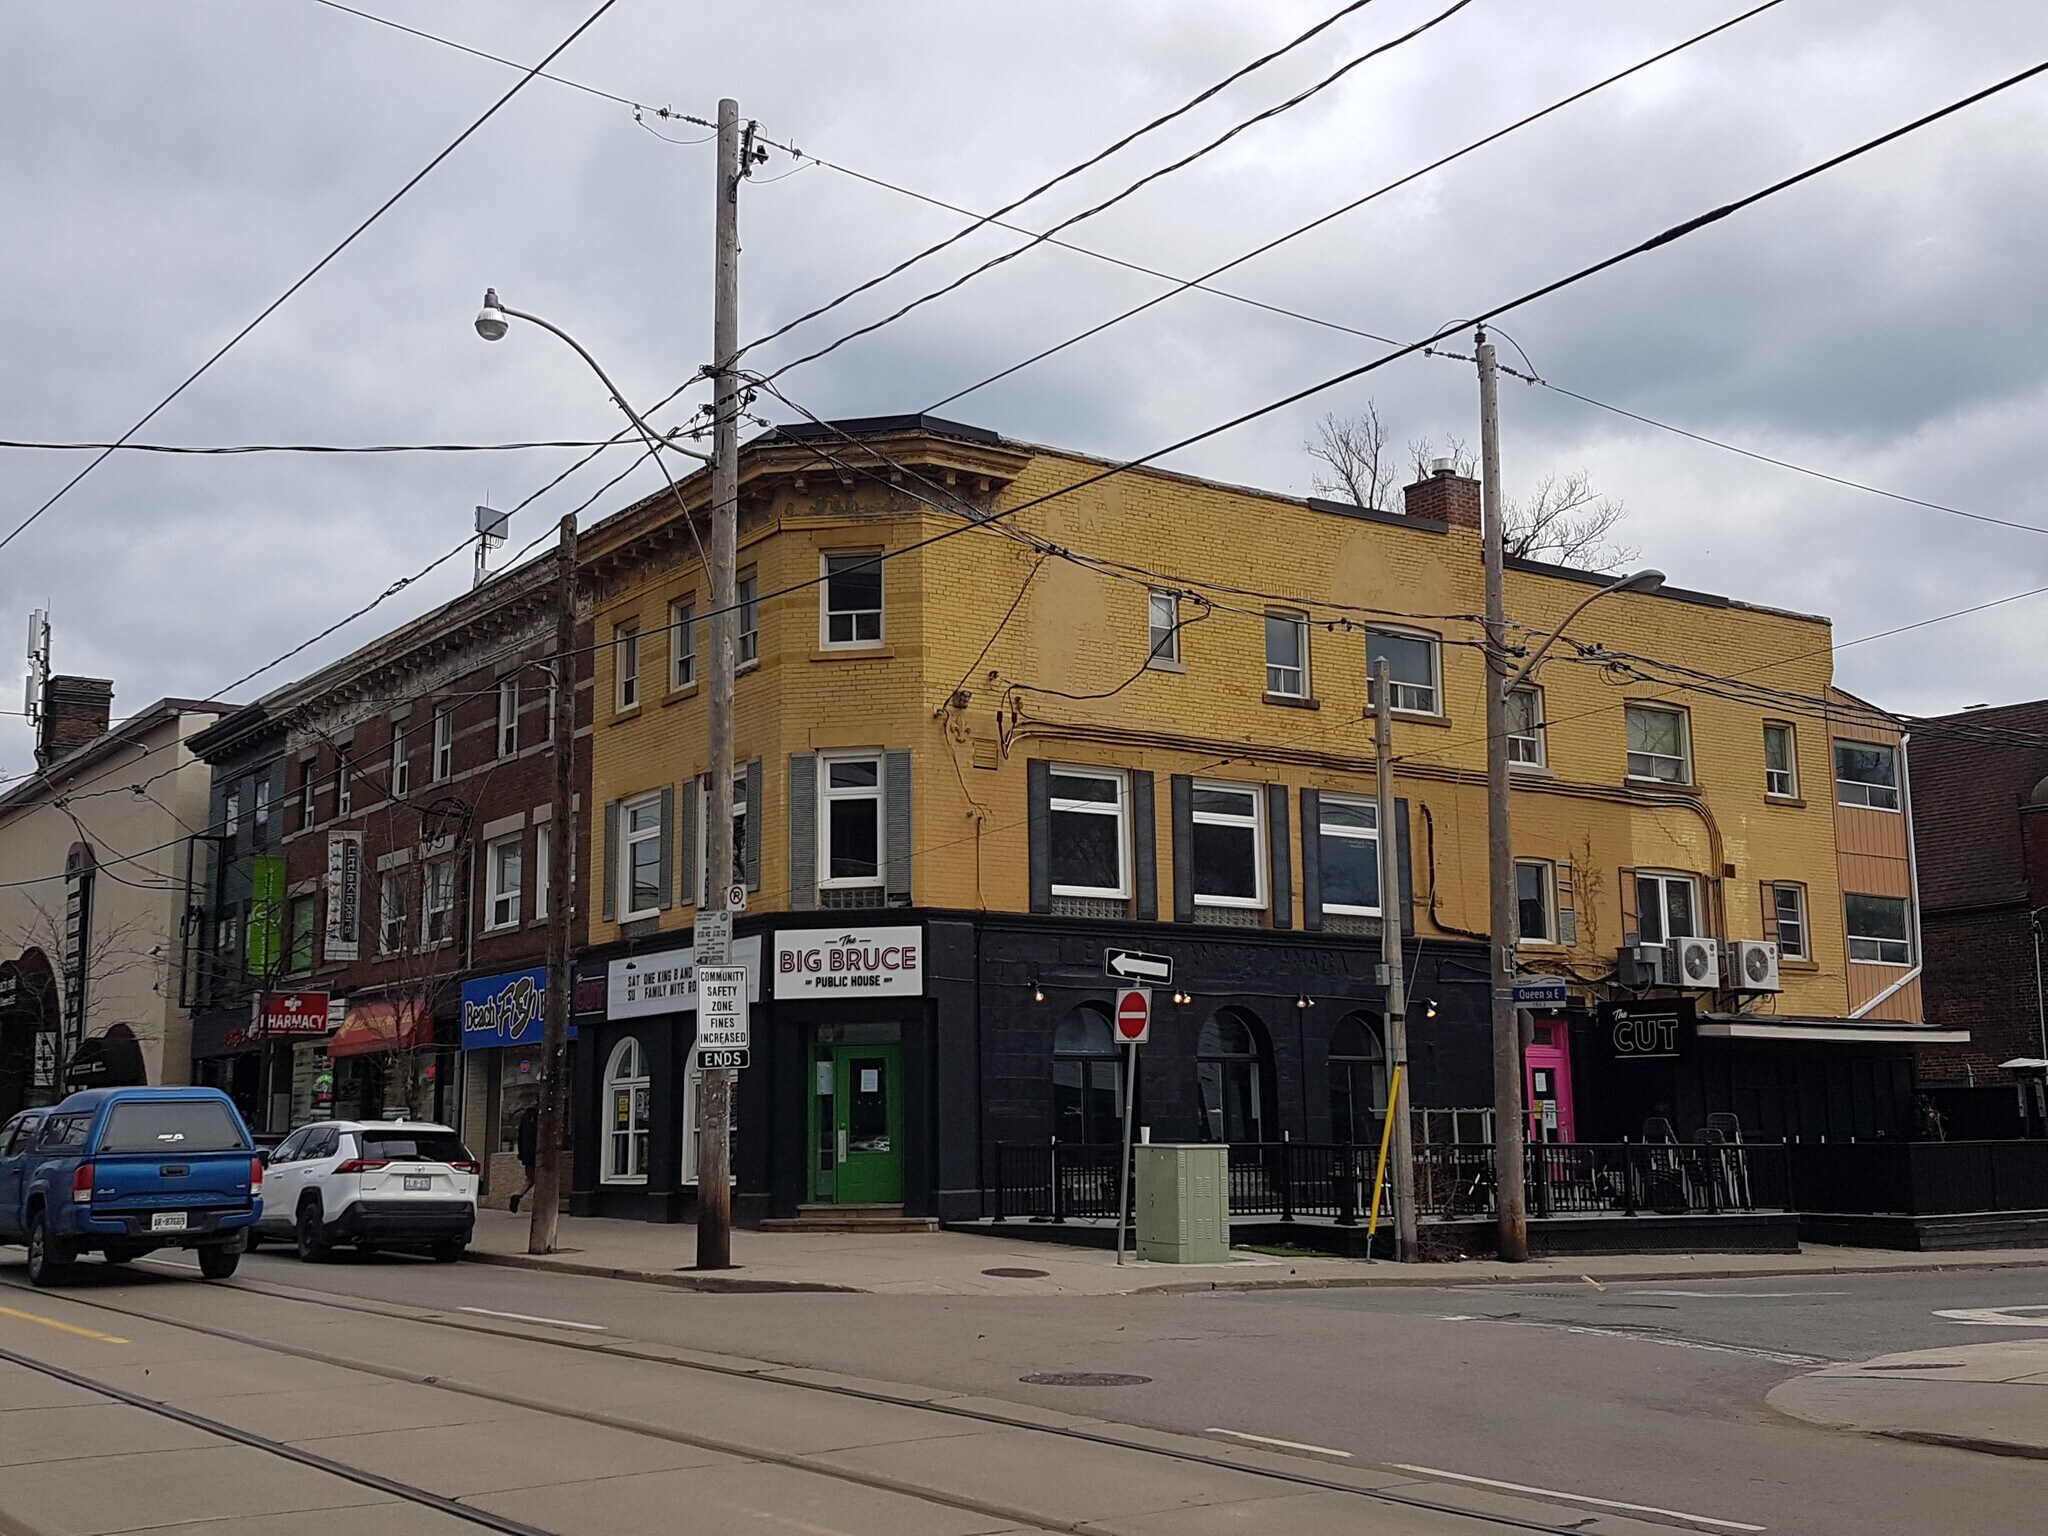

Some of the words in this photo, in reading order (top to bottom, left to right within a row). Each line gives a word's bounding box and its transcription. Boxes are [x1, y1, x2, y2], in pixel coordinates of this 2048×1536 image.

[839, 934, 857, 947] The
[780, 949, 822, 973] BIG
[829, 947, 916, 971] BRUCE
[628, 975, 640, 987] SAT
[657, 970, 672, 983] KING
[700, 971, 744, 982] COMMUNITY
[815, 976, 848, 987] PUBLIC
[851, 975, 881, 986] HOUSE
[645, 985, 667, 999] FAMILY
[670, 982, 684, 996] NITE
[707, 986, 737, 997] SAFETY
[1519, 989, 1545, 1000] Queen
[1554, 988, 1560, 999] E
[712, 1001, 733, 1011] ZONE
[465, 995, 497, 1032] Beach
[1612, 1008, 1628, 1022] The
[710, 1017, 735, 1028] FINES
[700, 1032, 746, 1044] INCREASED
[1613, 1019, 1679, 1052] CUT
[705, 1052, 742, 1066] ENDS
